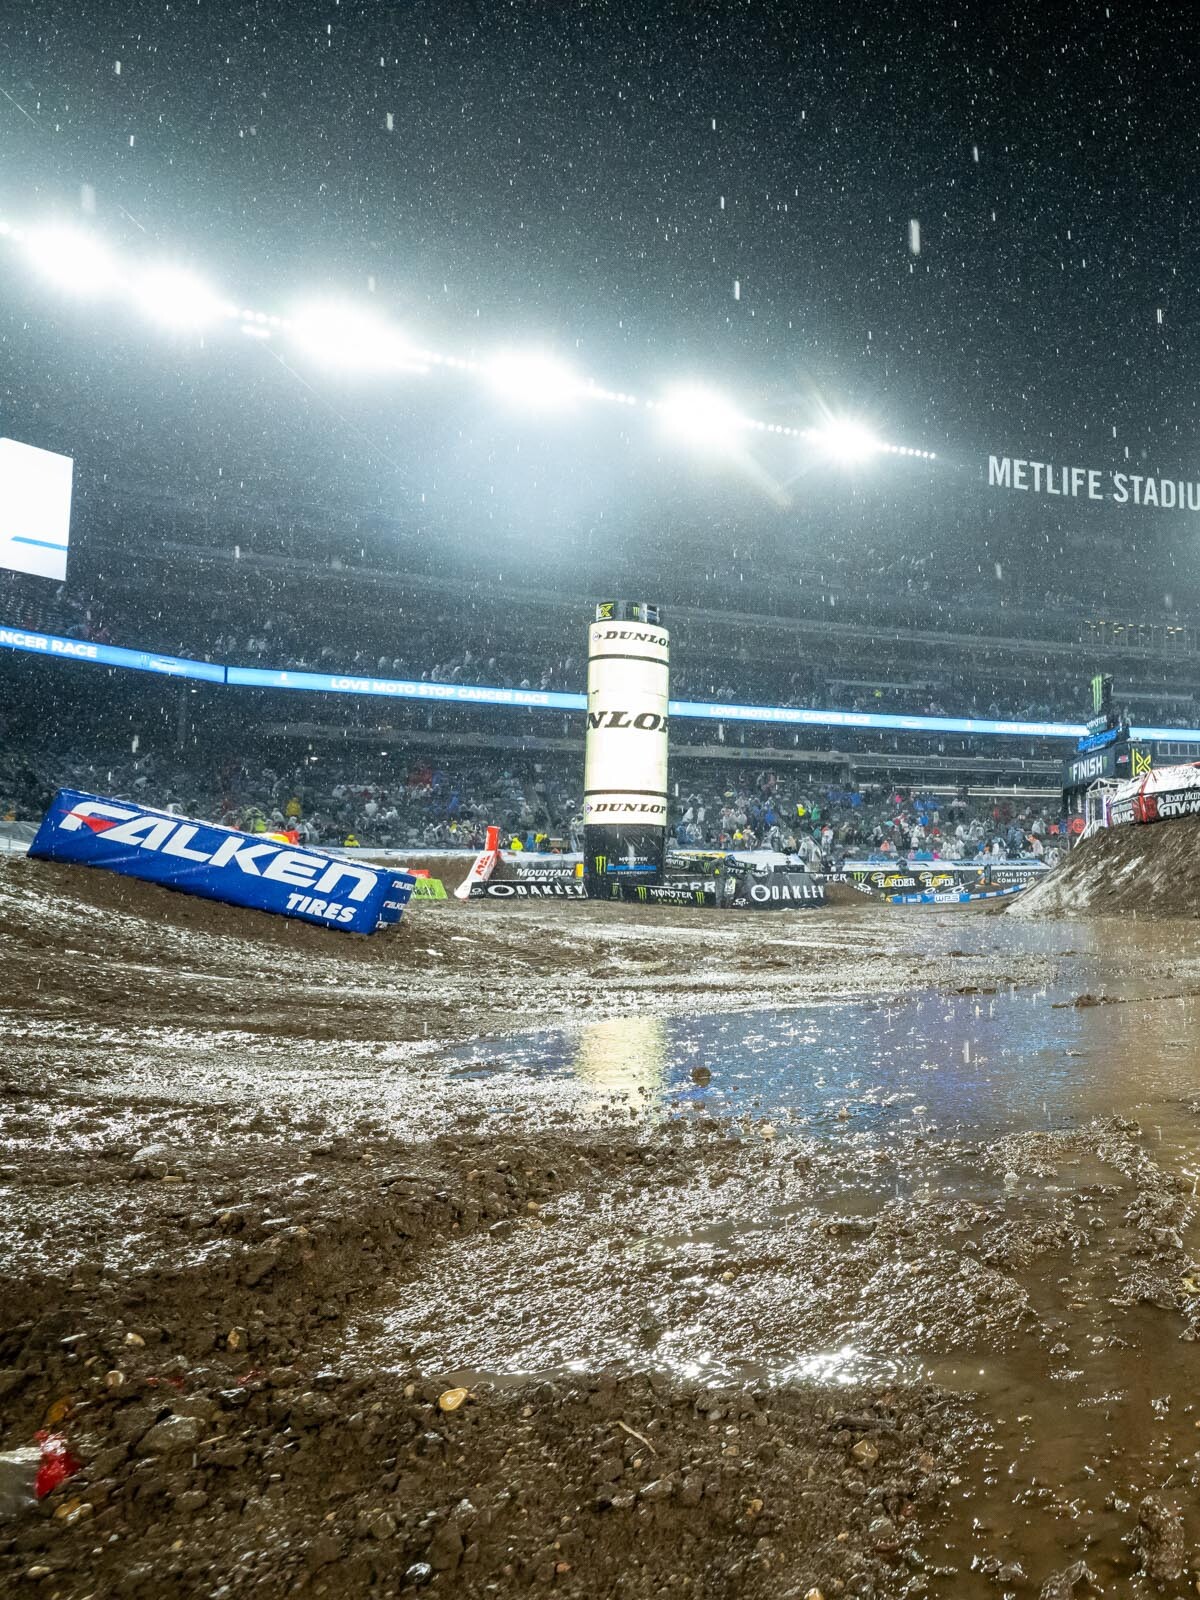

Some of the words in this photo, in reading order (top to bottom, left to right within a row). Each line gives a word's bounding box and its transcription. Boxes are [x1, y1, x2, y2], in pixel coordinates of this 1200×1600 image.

[989, 455, 1103, 500] METLIFE
[0, 630, 48, 650] NCER
[52, 640, 97, 658] RACE
[604, 631, 669, 648] DUNLO
[330, 678, 369, 691] LOVE
[373, 680, 416, 694] MOTO
[419, 684, 454, 697] STOP
[458, 688, 512, 701] CANCER
[514, 692, 549, 704] RACE
[710, 706, 738, 716] LOVE
[740, 708, 772, 718] MOTO
[774, 710, 800, 719] STOP
[588, 711, 668, 733] NLO
[1072, 755, 1102, 782] FINISH
[1166, 794, 1184, 803] ROCKY
[594, 803, 666, 814] DUNLOP
[59, 802, 378, 902] FALKEN
[516, 868, 573, 877] MOUNTAIN
[516, 885, 583, 895] OAKLEY
[878, 878, 916, 888] HARDER
[650, 889, 693, 899] MONSTER
[772, 885, 824, 899] OAKLEY
[935, 894, 959, 903] WPS
[286, 893, 356, 923] TIRES
